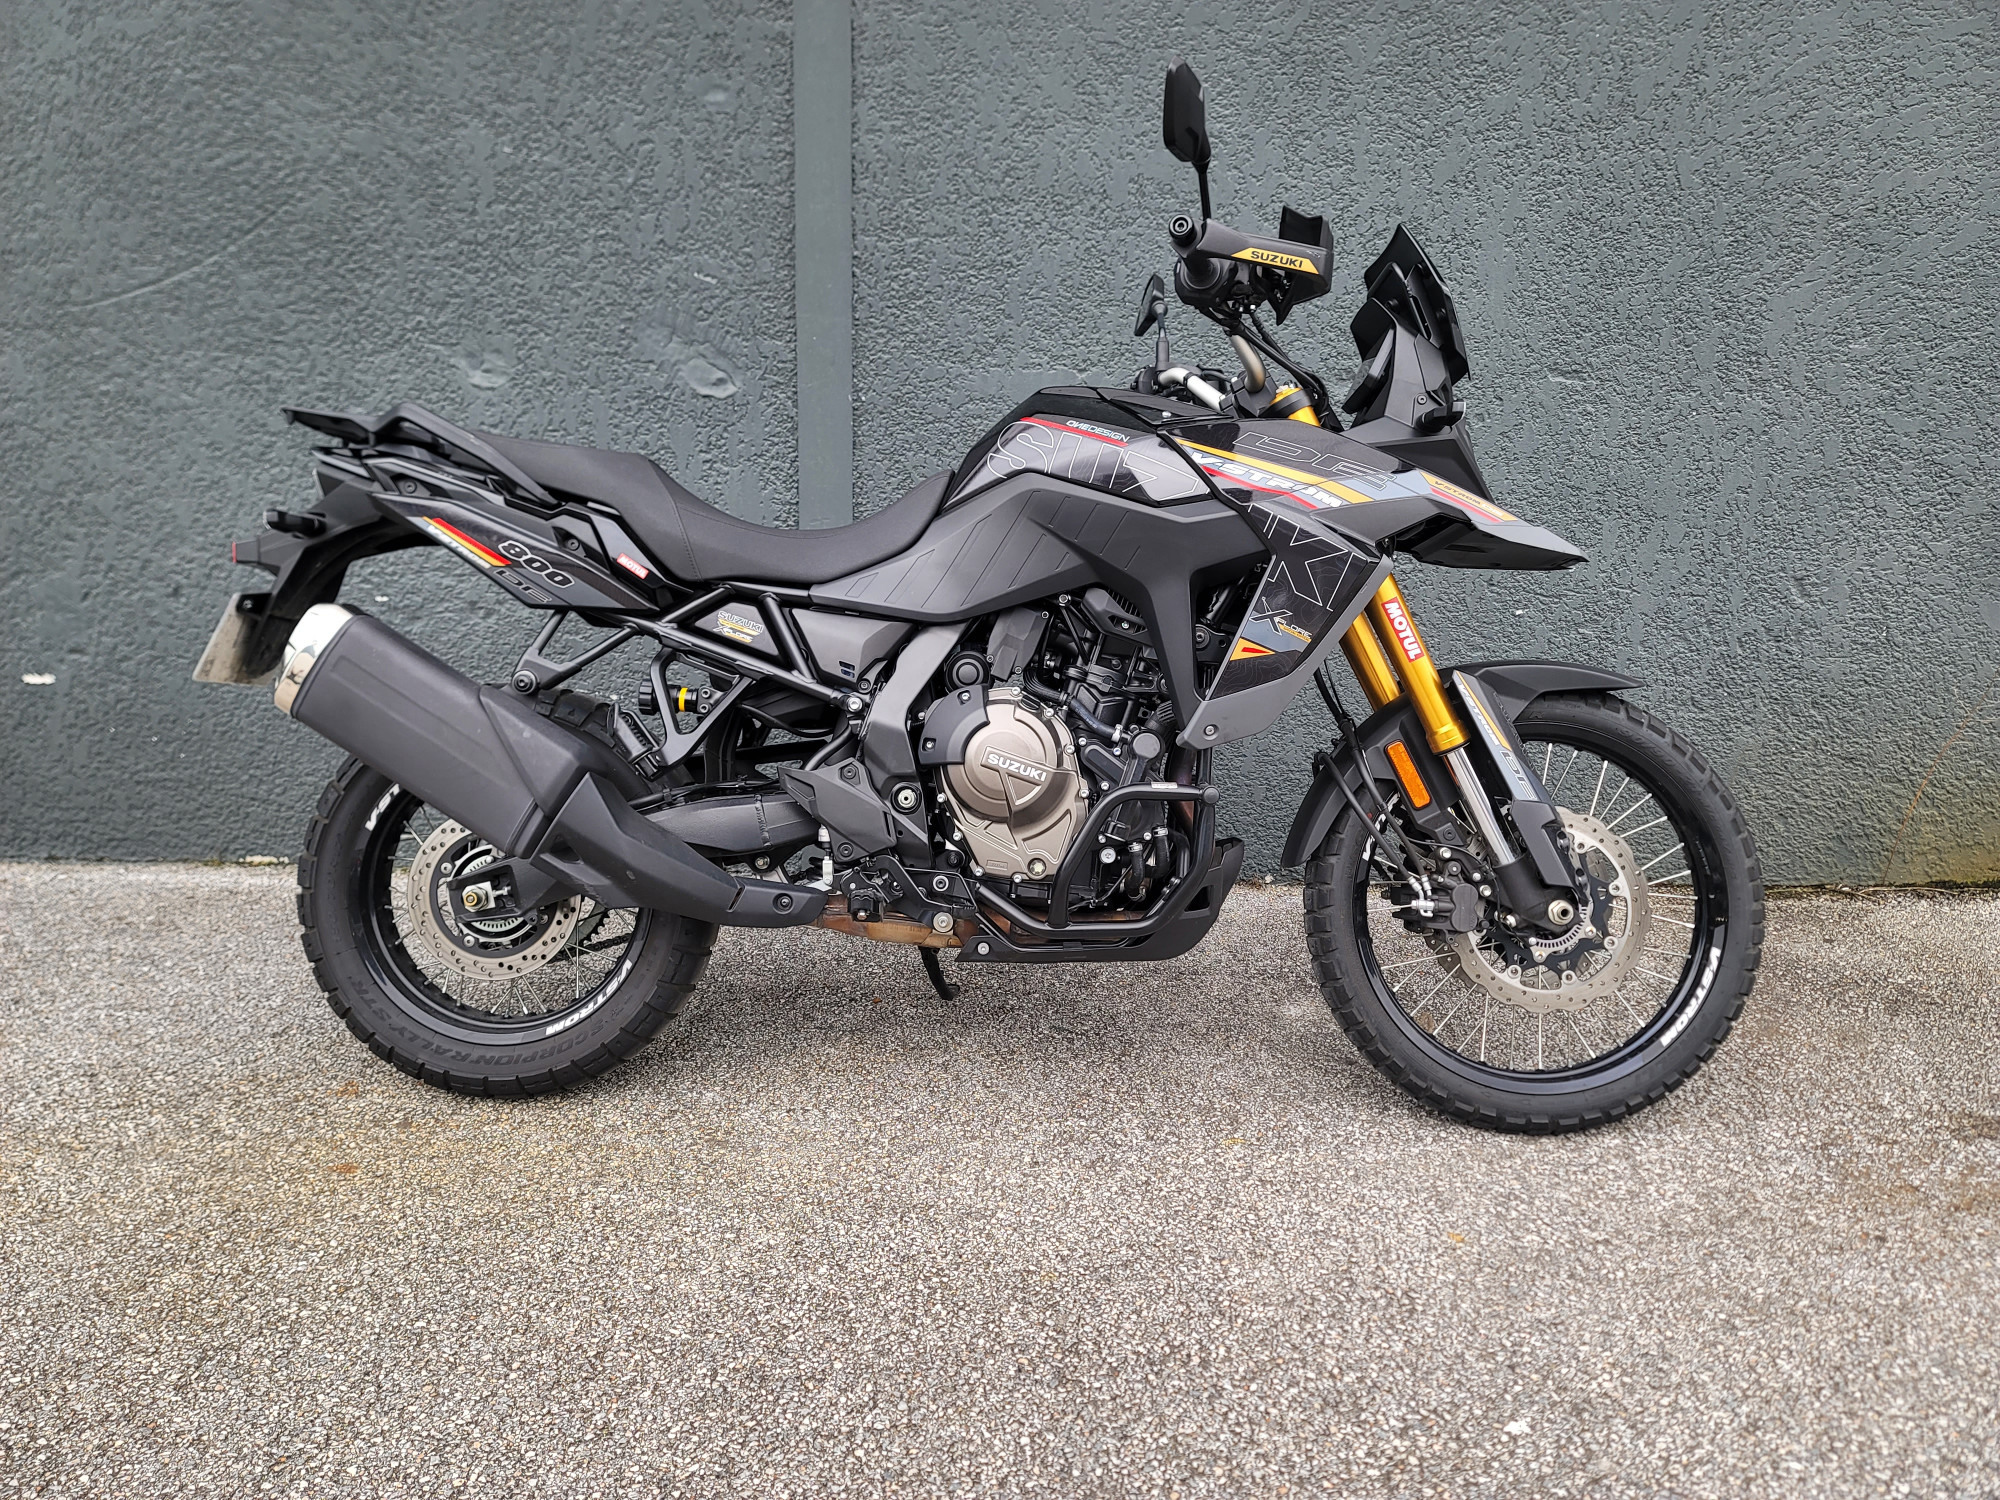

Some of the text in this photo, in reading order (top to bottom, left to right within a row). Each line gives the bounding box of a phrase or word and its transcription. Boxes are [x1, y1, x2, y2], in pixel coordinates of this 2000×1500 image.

[1250, 250, 1304, 268] SUZUKI
[1066, 420, 1130, 442] ONEDESIGN
[1191, 451, 1344, 508] V-STROM
[497, 540, 575, 589] 800
[619, 555, 647, 578] MOTUL
[717, 610, 765, 634] SUZUKI
[1384, 602, 1422, 660] MOTUL
[987, 753, 1047, 782] SUZUKI
[545, 959, 633, 1035] V-STROM
[1660, 946, 1721, 1047] V-STROM
[389, 1024, 472, 1063] RALLY
[479, 1015, 605, 1066] SCORPION
